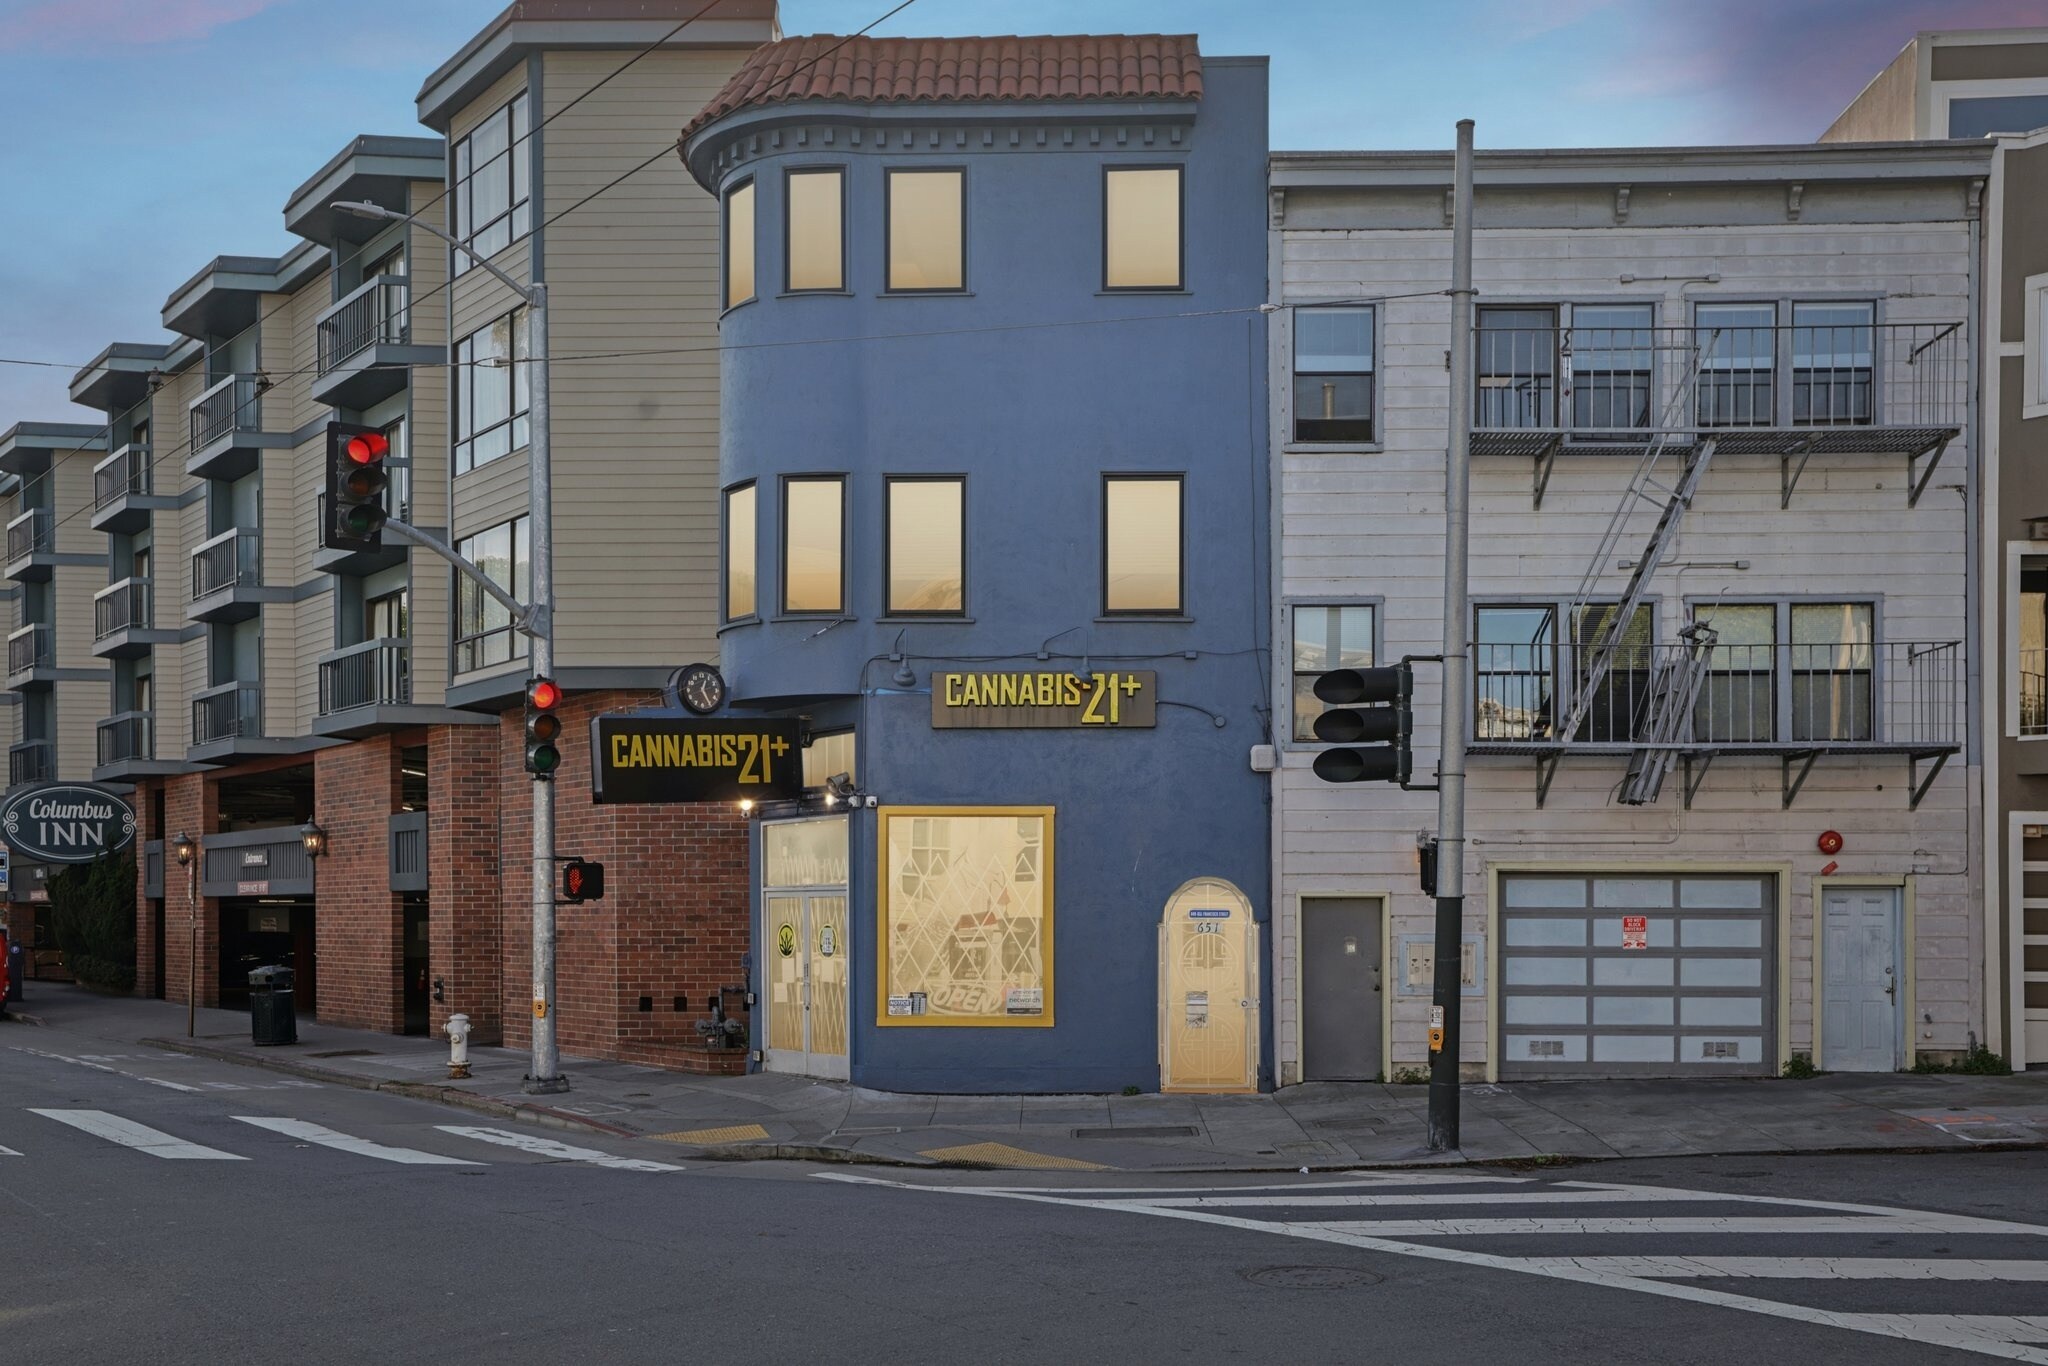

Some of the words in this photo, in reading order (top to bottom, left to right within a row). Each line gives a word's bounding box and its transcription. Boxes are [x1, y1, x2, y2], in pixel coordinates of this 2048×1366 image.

[945, 673, 1081, 706] CANNABIS
[611, 734, 737, 768] CANNABIS
[738, 734, 789, 784] 21+
[29, 798, 114, 819] Columbus
[39, 822, 104, 846] INN
[245, 852, 263, 864] Entrance
[1198, 922, 1219, 933] 651
[933, 986, 999, 1013] OPEN
